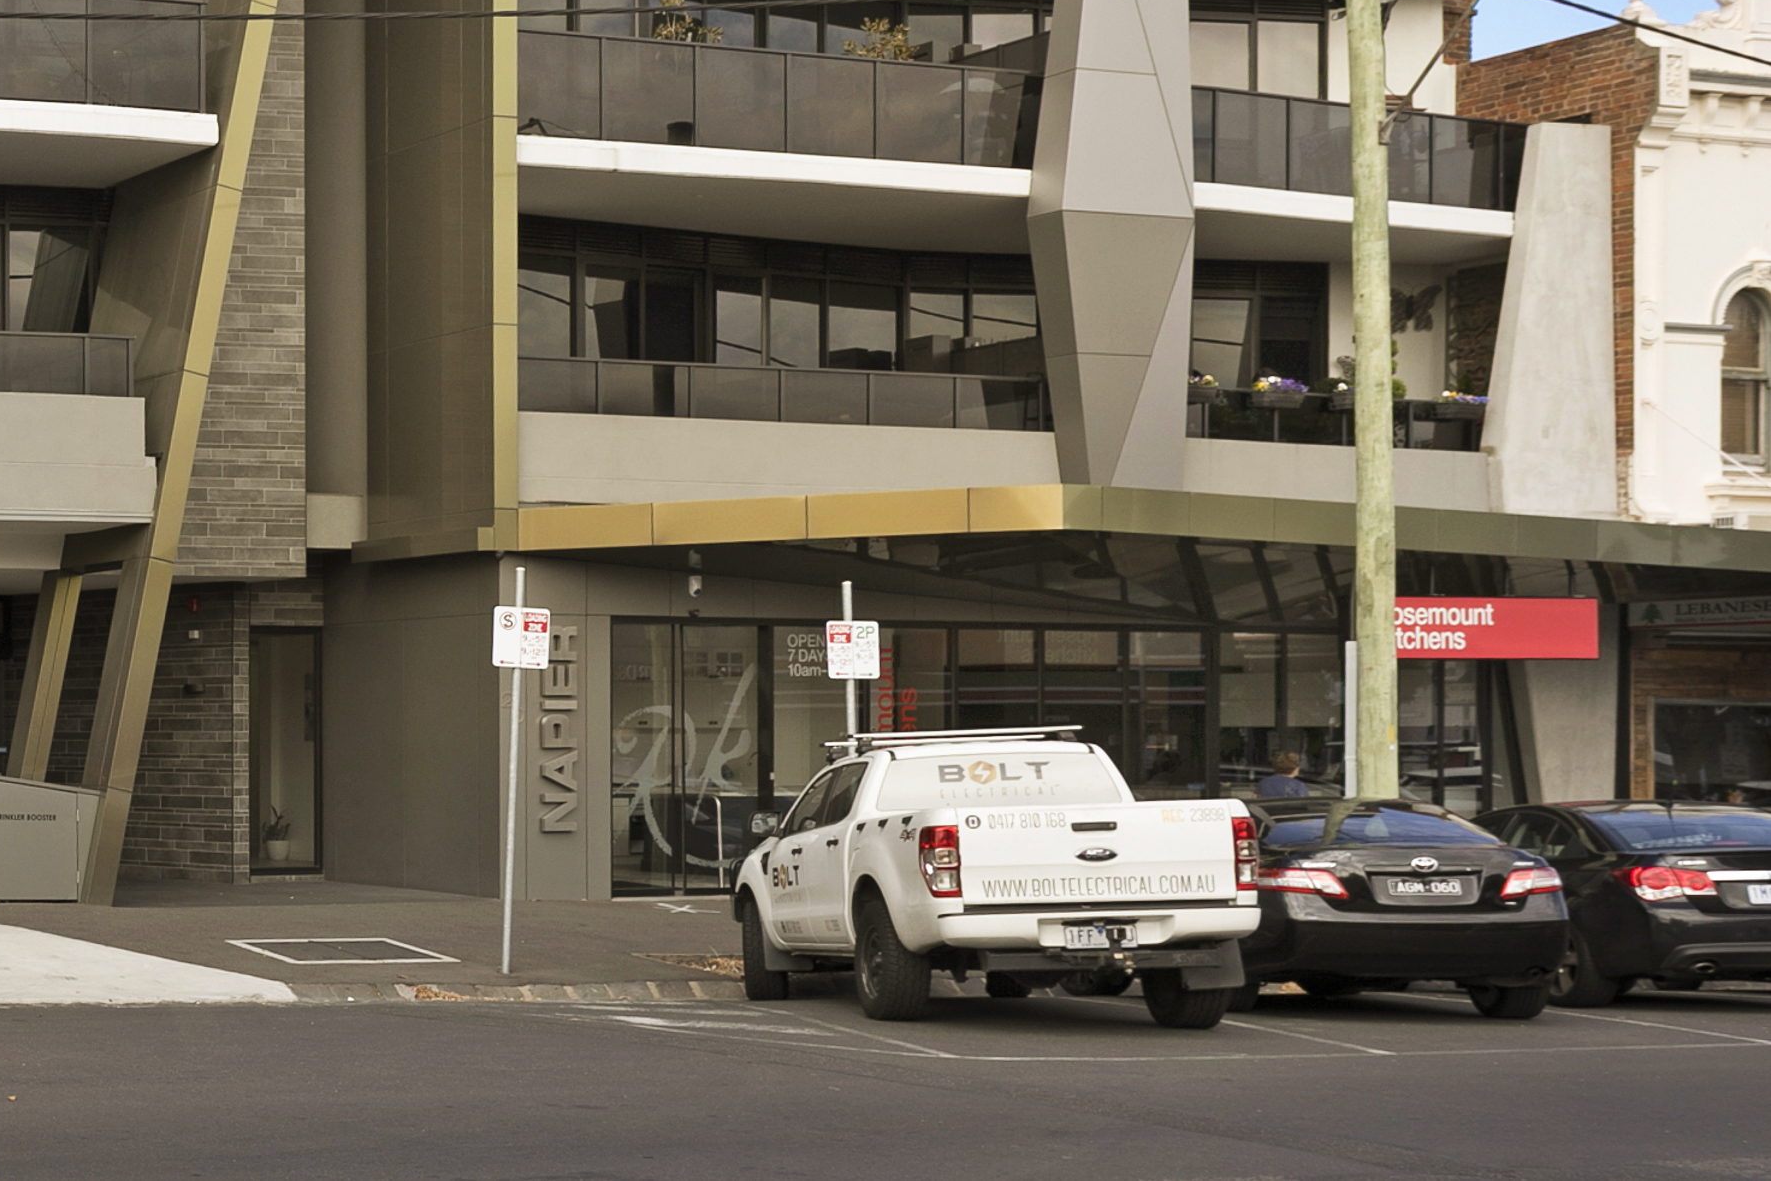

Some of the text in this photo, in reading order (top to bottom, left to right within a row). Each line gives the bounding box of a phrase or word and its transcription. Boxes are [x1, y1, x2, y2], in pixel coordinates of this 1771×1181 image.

[1393, 603, 1495, 626] osemount
[856, 626, 875, 639] 2P
[1395, 626, 1467, 650] tchens
[787, 634, 826, 648] OPEN
[787, 649, 796, 662] 7
[799, 649, 827, 662] DAY
[540, 625, 578, 833] NAPIER
[939, 785, 1059, 800] ELECTRICAL
[27, 813, 57, 821] BOOSTER
[987, 811, 1067, 830] 0417 810 168
[1161, 808, 1185, 823] REC
[981, 874, 1217, 898] WWW.BOLTELECTRICAL.COM.AU
